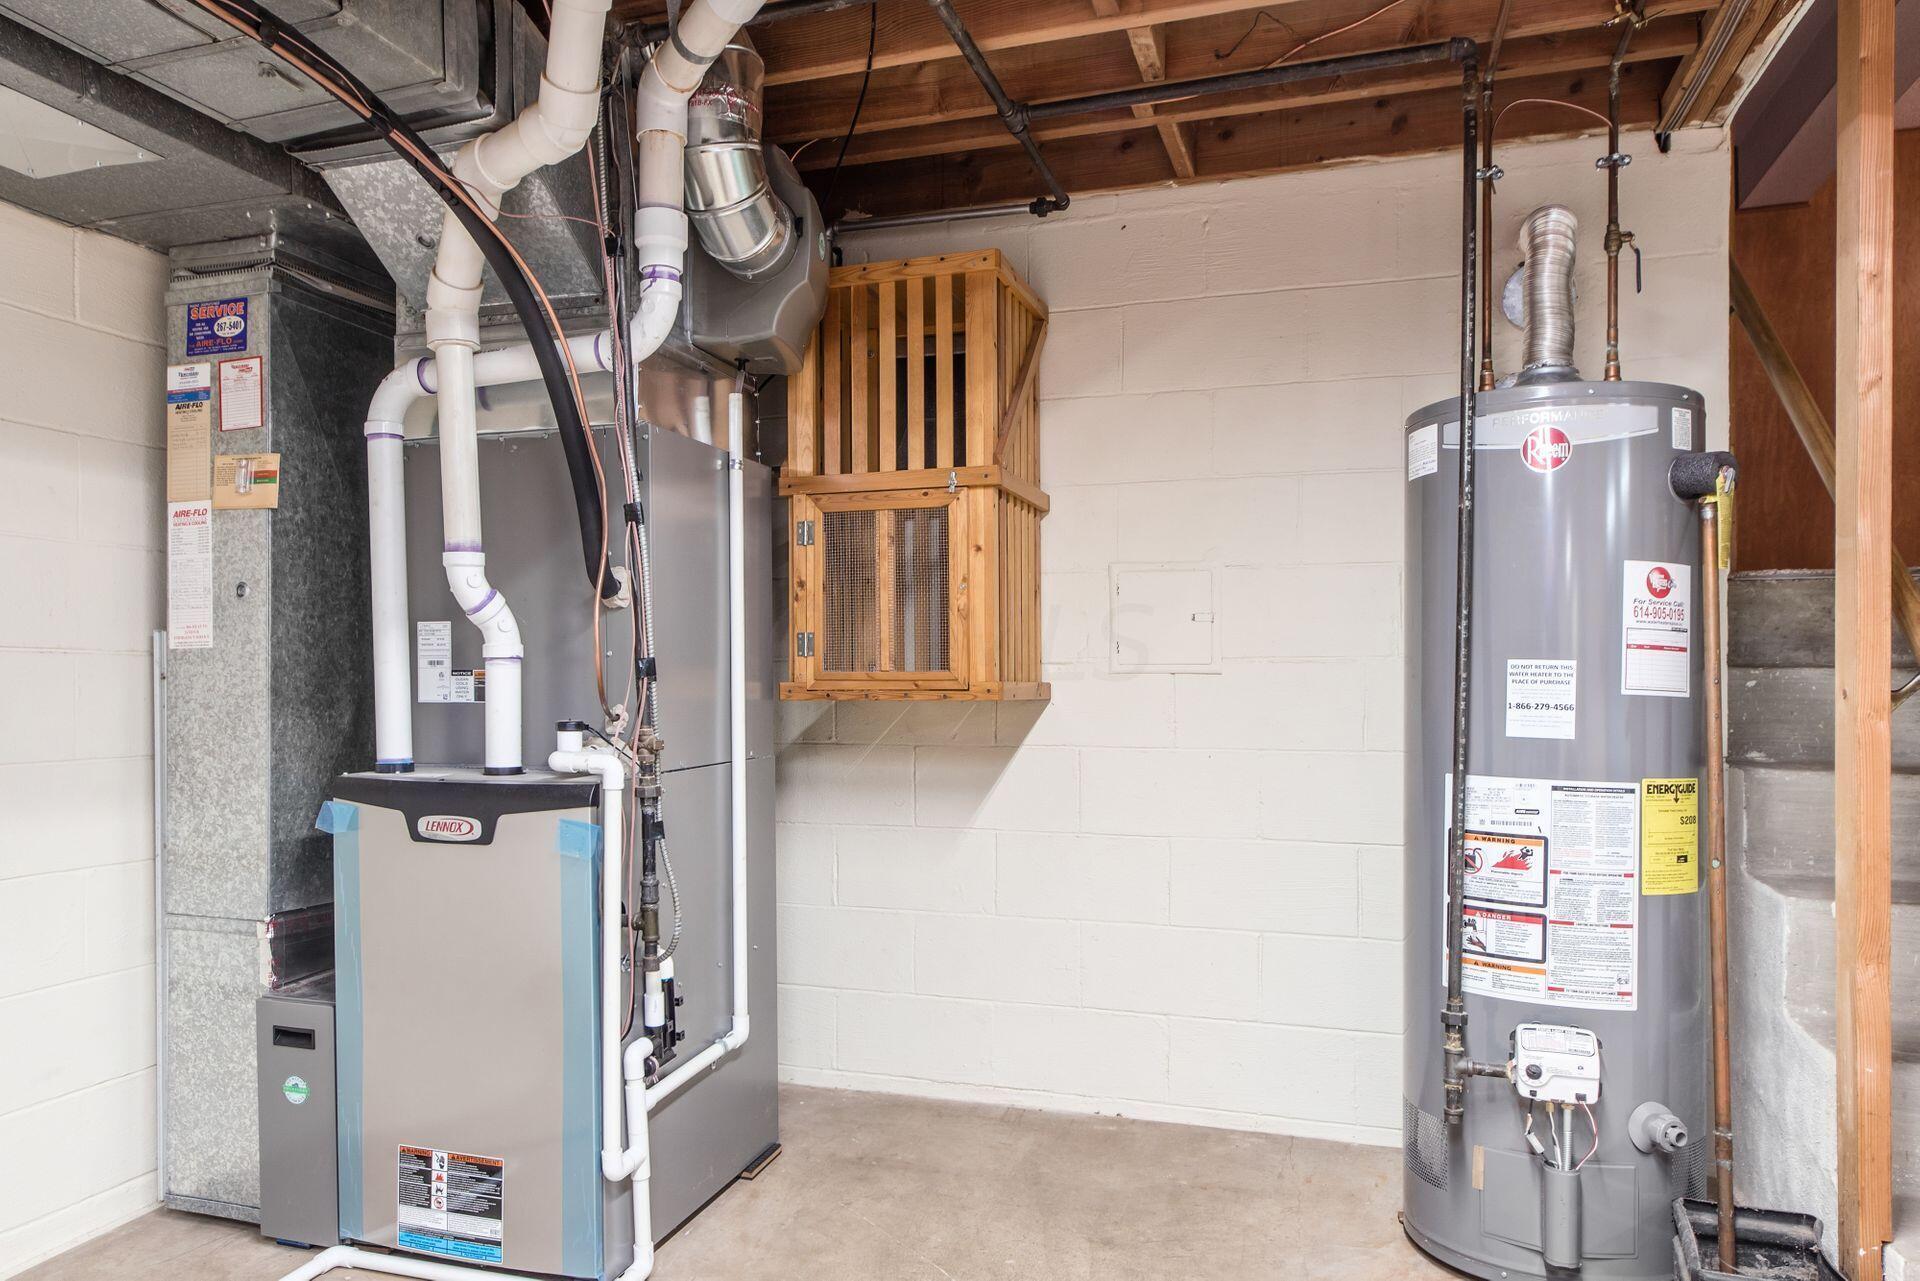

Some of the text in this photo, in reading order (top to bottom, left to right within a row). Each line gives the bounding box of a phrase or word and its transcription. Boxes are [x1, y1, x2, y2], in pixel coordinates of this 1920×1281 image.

[190, 302, 244, 320] SERVICE
[216, 320, 242, 332] 267-5401
[196, 338, 232, 348] AIRE-FLO
[175, 402, 203, 410] AIRE-FLO
[1527, 426, 1569, 466] Rheem
[173, 508, 207, 518] AIRE-FLO
[1633, 606, 1684, 621] 614-905-0195
[1508, 702, 1575, 711] 1-866-279-4566
[1647, 783, 1696, 795] ENERGYGUIDE
[425, 820, 464, 833] LENNOX
[1482, 962, 1512, 970] WARNING
[406, 1147, 432, 1157] WARNING
